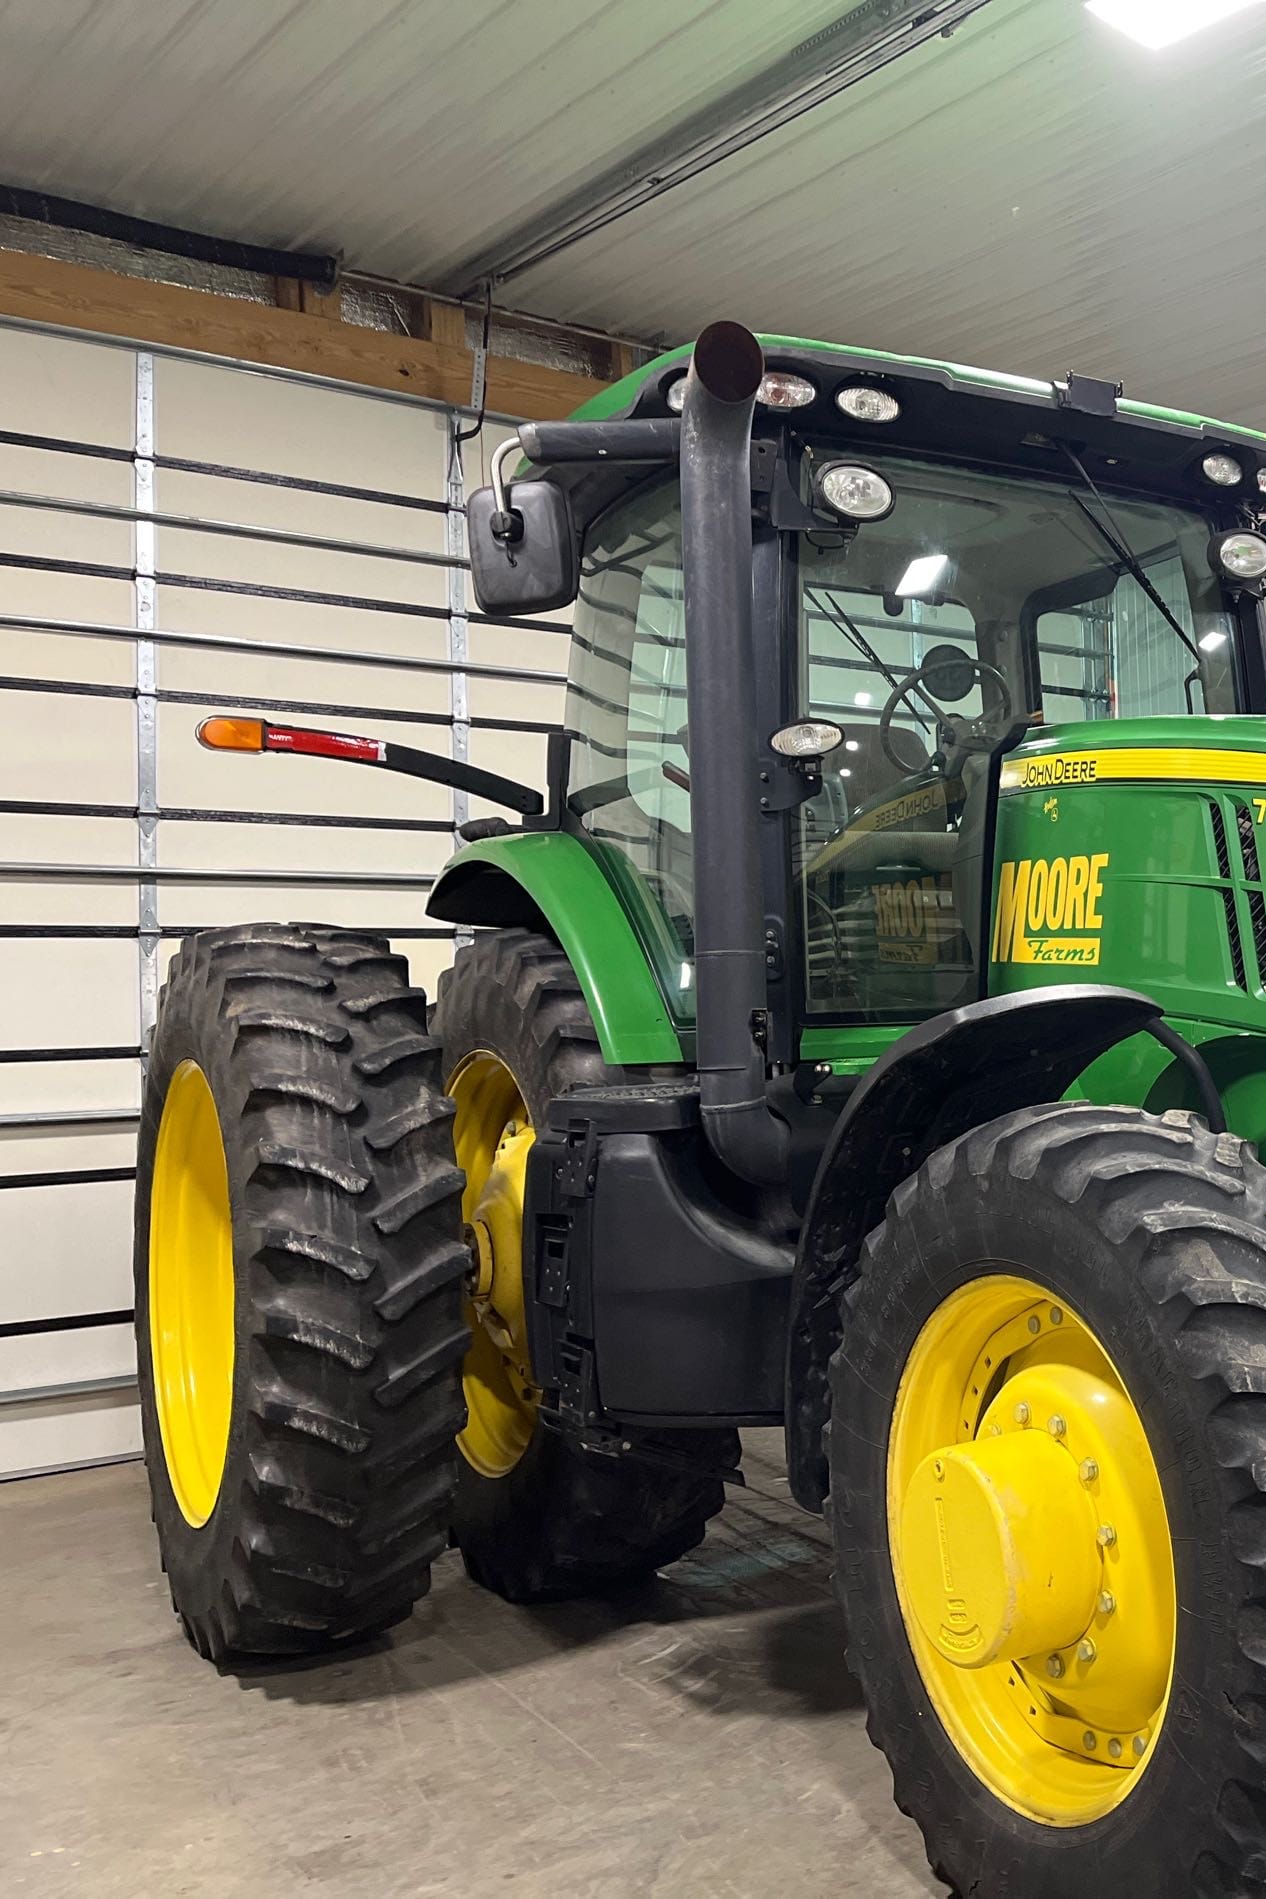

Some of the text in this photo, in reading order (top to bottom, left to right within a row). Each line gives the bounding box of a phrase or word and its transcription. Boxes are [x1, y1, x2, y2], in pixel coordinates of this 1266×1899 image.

[1021, 759, 1097, 784] JOHN DEERE
[992, 853, 1109, 963] MOORE
[1027, 939, 1096, 961] Farms
